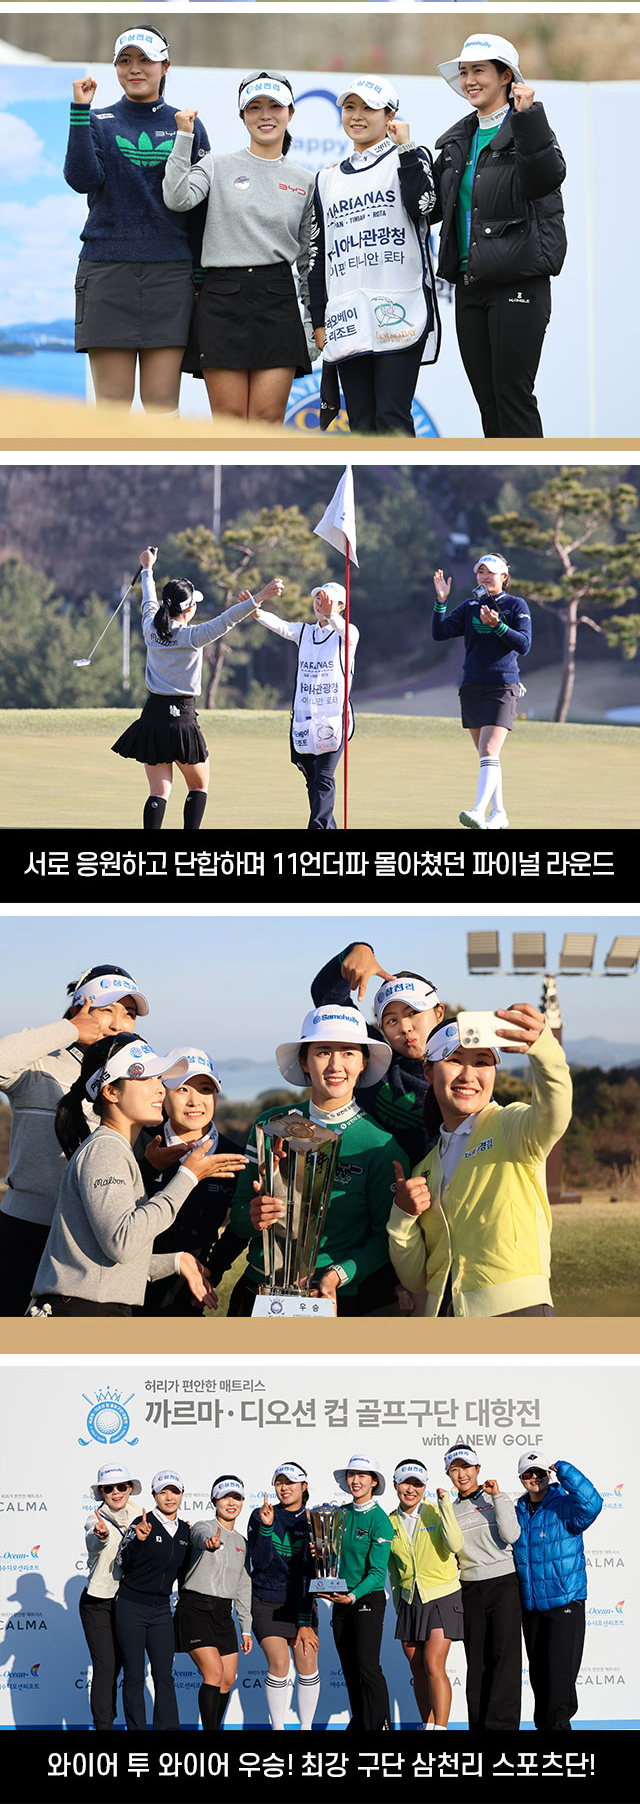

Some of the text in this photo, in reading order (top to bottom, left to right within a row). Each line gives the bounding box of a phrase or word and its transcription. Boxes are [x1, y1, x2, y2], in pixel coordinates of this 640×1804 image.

[278, 182, 306, 196] BYD
[348, 251, 379, 269] 티니안
[384, 250, 405, 265] 로타
[385, 983, 415, 995] 삼천리
[90, 1070, 111, 1093] PING
[144, 1379, 266, 1393] 허리가 편안한 매트리스
[324, 1398, 348, 1428] 컵
[356, 1398, 460, 1428] 골프구단
[465, 1398, 541, 1428] 대항전
[422, 1434, 543, 1446] with ANEW GOLF
[0, 1501, 48, 1512] CALMA
[179, 1501, 215, 1511] LMA
[586, 1558, 625, 1568] ALMA
[0, 1620, 48, 1630] CALMA
[575, 1675, 626, 1685] CALMA
